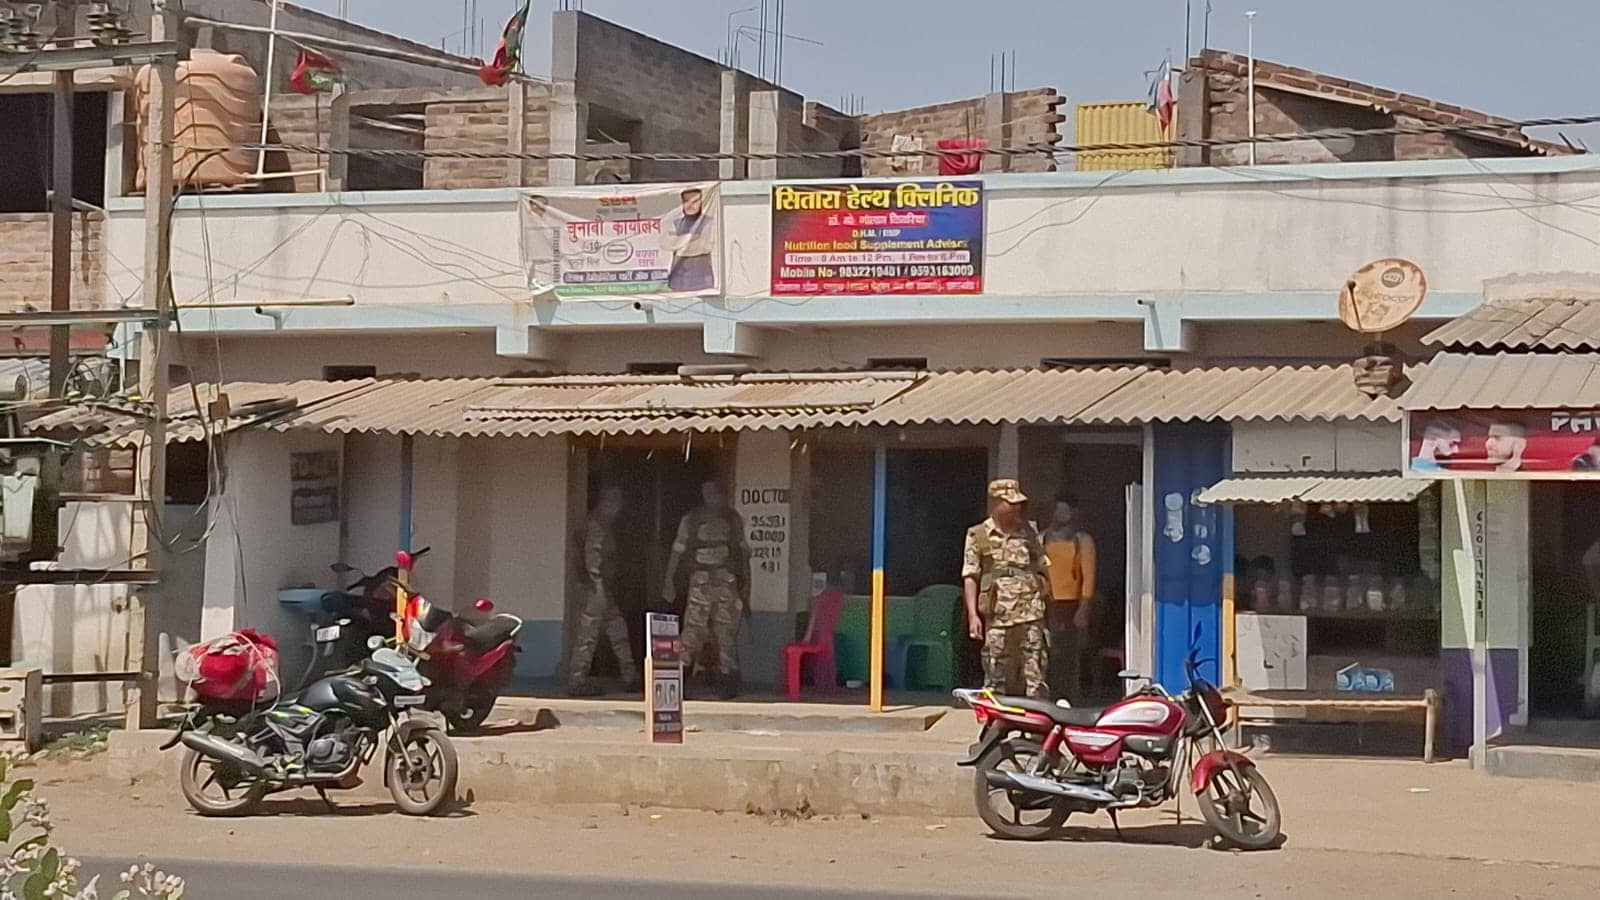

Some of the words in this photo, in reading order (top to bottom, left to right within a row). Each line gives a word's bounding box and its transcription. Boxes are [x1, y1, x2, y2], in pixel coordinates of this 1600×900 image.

[776, 186, 840, 210] सितारा
[847, 184, 890, 209] हेल्थ
[897, 182, 980, 208] क्लिनिक
[566, 214, 604, 242] चुनावी
[612, 213, 662, 235] कार्यालय
[784, 240, 831, 251] Nutrition
[860, 239, 924, 252] Supplement
[789, 254, 812, 263] Time
[781, 266, 816, 278] Mobile
